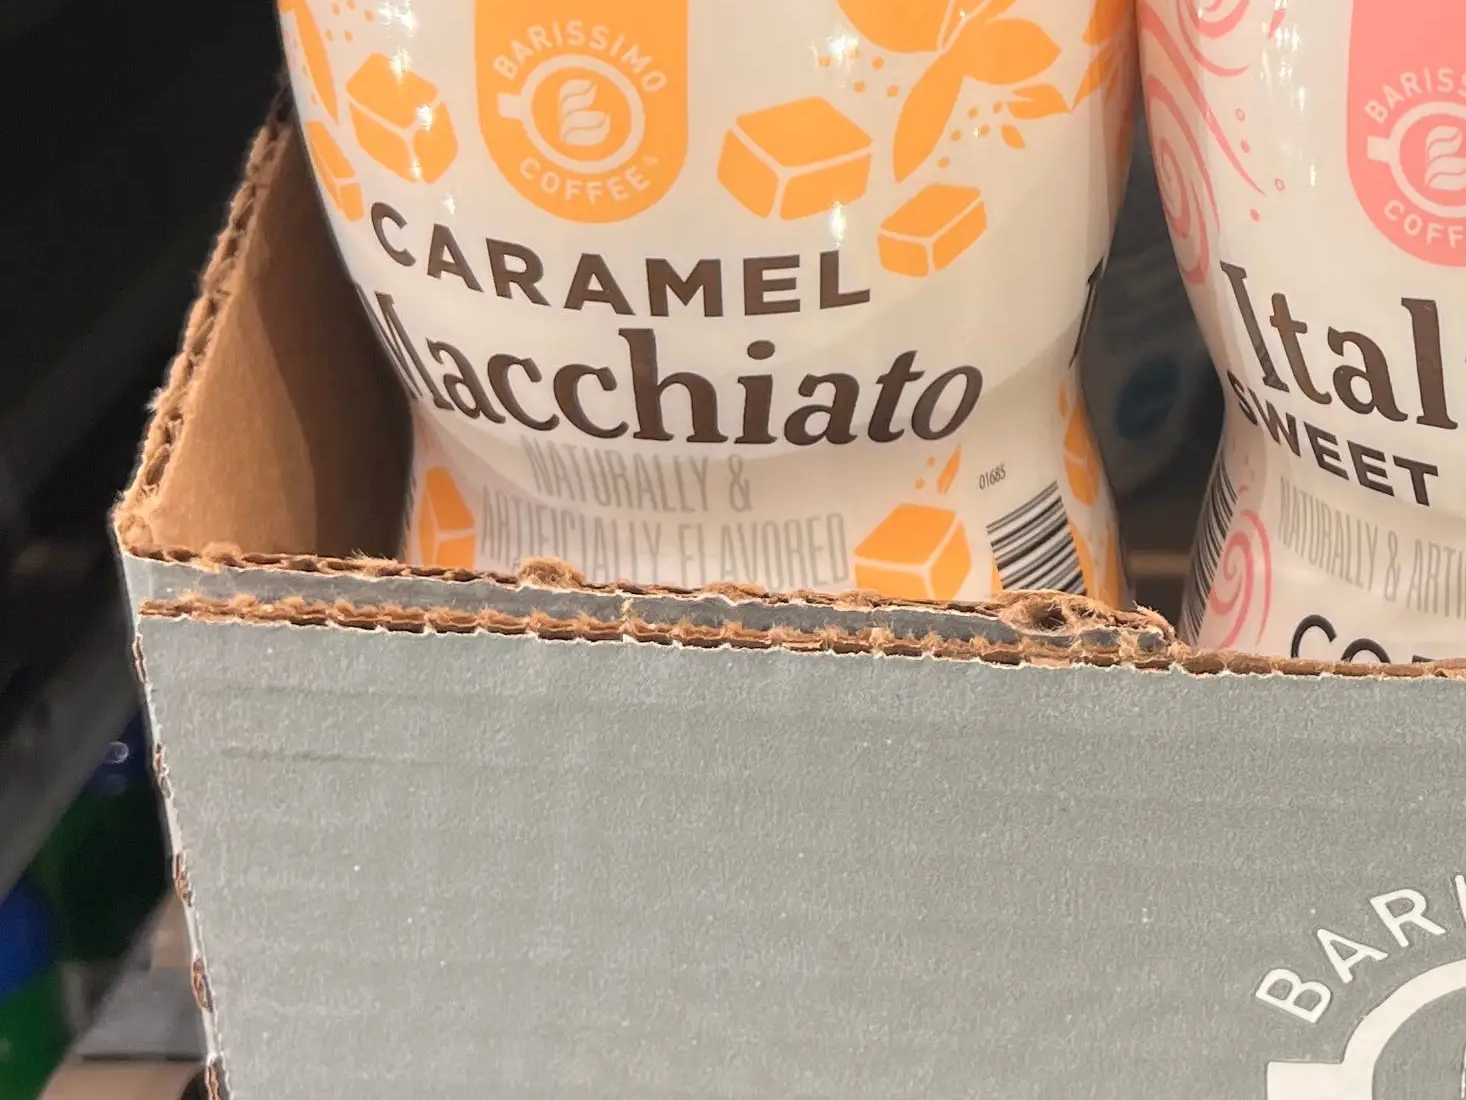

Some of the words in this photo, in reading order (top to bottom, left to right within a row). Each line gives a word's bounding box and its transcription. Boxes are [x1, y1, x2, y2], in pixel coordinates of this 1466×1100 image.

[492, 19, 668, 93] BARISSIMO
[519, 157, 653, 205] COFFEE
[370, 201, 871, 317] CARAMEL
[520, 435, 709, 513] NATURALLY
[728, 453, 754, 513] &
[1226, 369, 1438, 508] SWEET
[678, 512, 850, 593] FLAVORED
[1278, 475, 1379, 593] NATURALLY
[1383, 530, 1401, 603] &
